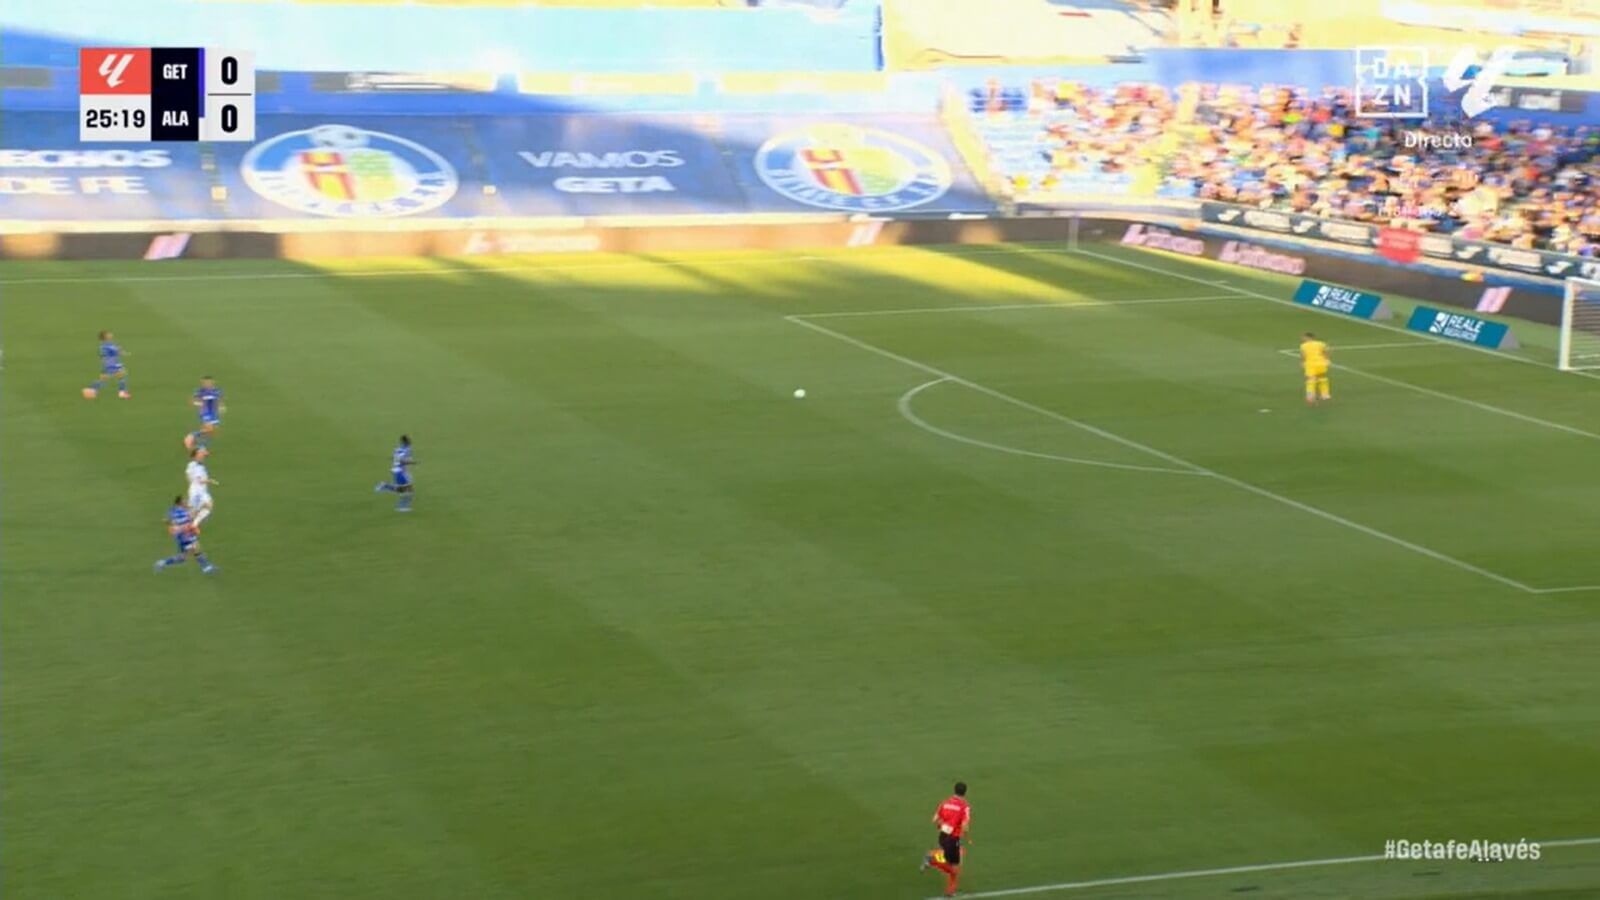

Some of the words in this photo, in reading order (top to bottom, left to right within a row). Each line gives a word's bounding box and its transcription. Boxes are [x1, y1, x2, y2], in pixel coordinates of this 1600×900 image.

[517, 149, 685, 169] VAMOS
[78, 176, 149, 194] FE
[552, 175, 676, 193] GETA
[1328, 286, 1361, 305] REALE
[1449, 314, 1485, 333] REALE
